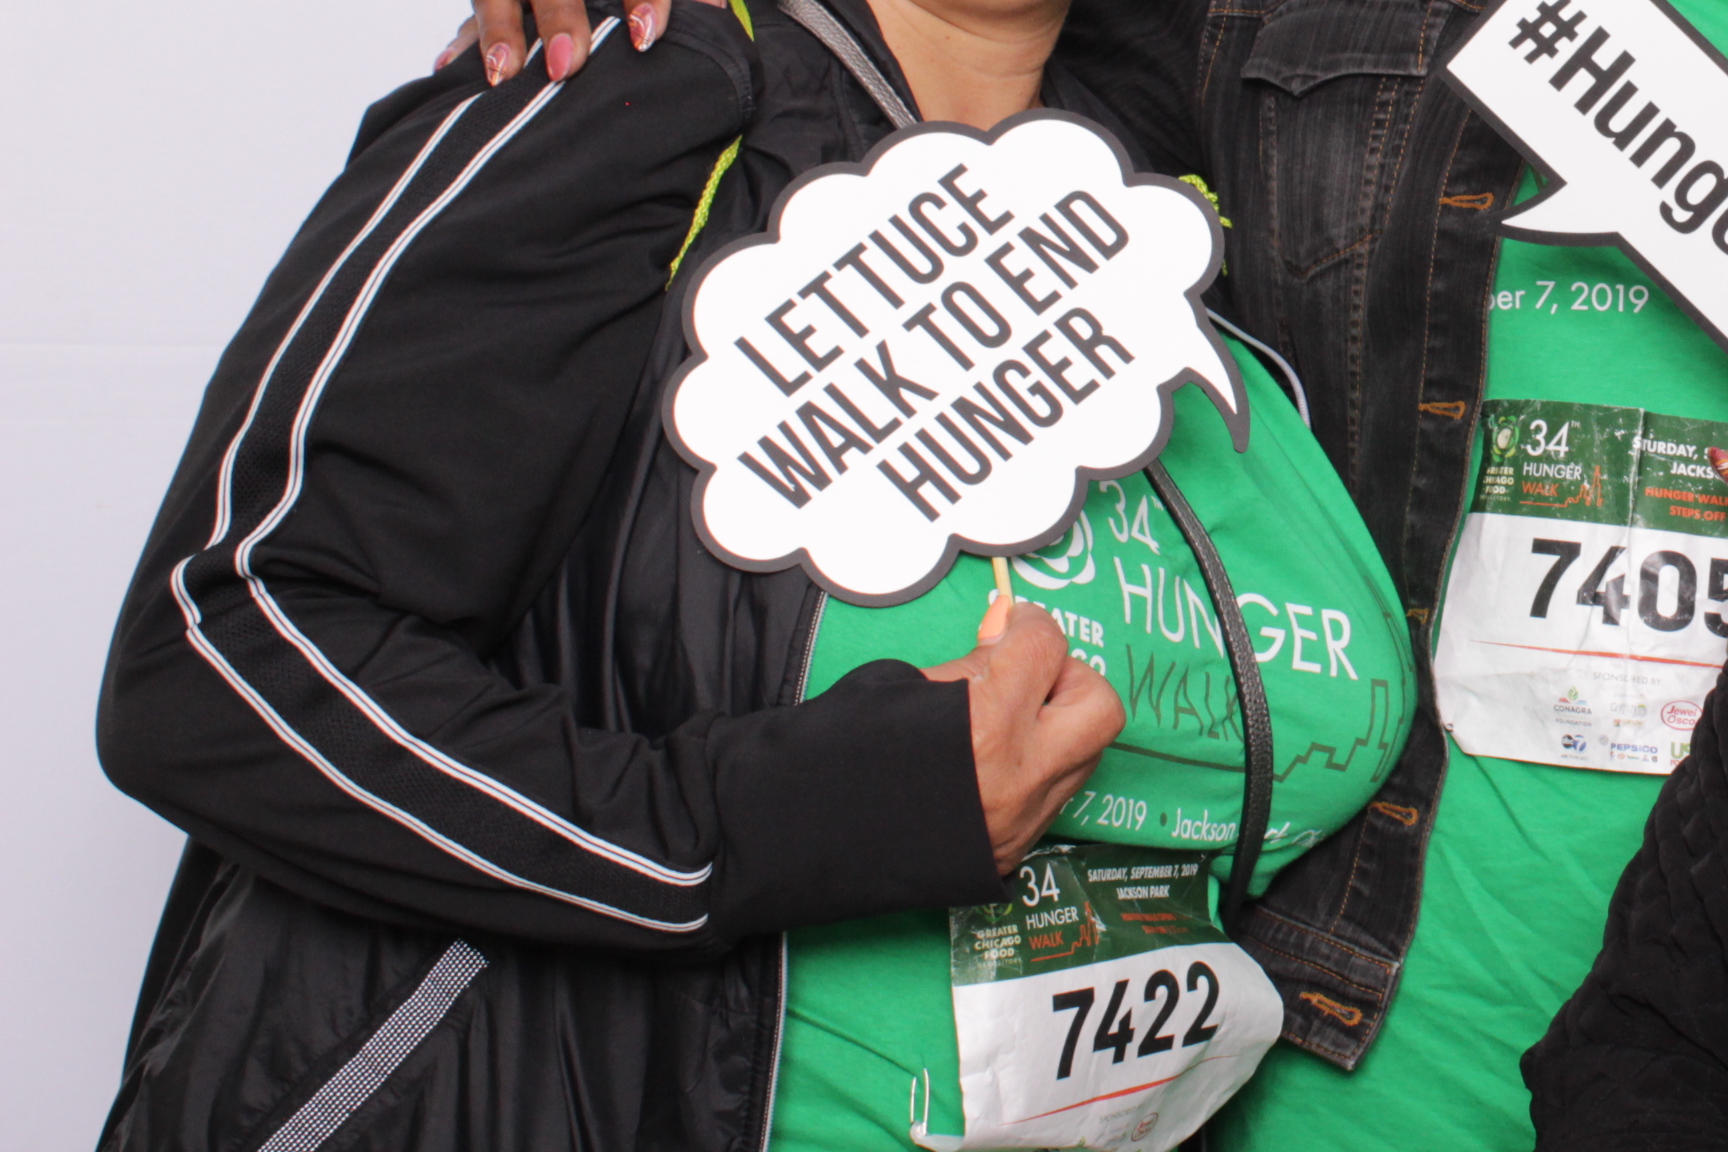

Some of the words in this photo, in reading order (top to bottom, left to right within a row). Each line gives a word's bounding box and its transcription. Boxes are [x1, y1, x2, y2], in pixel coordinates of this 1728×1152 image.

[733, 163, 1015, 397] LETTUCE
[1535, 281, 1558, 315] 7,
[1570, 281, 1649, 314] 2019
[736, 340, 939, 509] WALK
[902, 282, 1013, 372] TO
[984, 190, 1130, 316] END
[876, 307, 1136, 523] HUNGER
[1523, 462, 1582, 481] HUNGER
[1522, 481, 1560, 497] WALK
[1645, 487, 1695, 503] HUNGER
[1669, 505, 1701, 519] STEPS
[1704, 510, 1727, 522] OFF
[1113, 556, 1358, 680] HUNGER
[1126, 644, 1244, 742] WALK
[1553, 704, 1593, 715] CONAGRA
[1667, 705, 1697, 717] Jewel
[1555, 718, 1592, 727] FOUNDATION
[1610, 742, 1658, 754] PEPSICO
[1073, 791, 1097, 826] 7,
[1097, 794, 1148, 831] 2019
[1171, 807, 1237, 842] Jackson
[1087, 867, 1128, 882] SATURDAY,
[1130, 864, 1173, 879] SEPTEMBER
[1181, 863, 1199, 876] 2019
[1020, 862, 1060, 907] 34
[1116, 886, 1149, 900] JACKSON
[1150, 885, 1170, 898] PARK
[1026, 906, 1079, 930] HUNGER
[976, 924, 1018, 939] GREATER
[1028, 931, 1064, 950] WALK
[974, 935, 1021, 950] CHICAGO
[984, 947, 1015, 960] FOOD
[1052, 961, 1220, 1081] 7422
